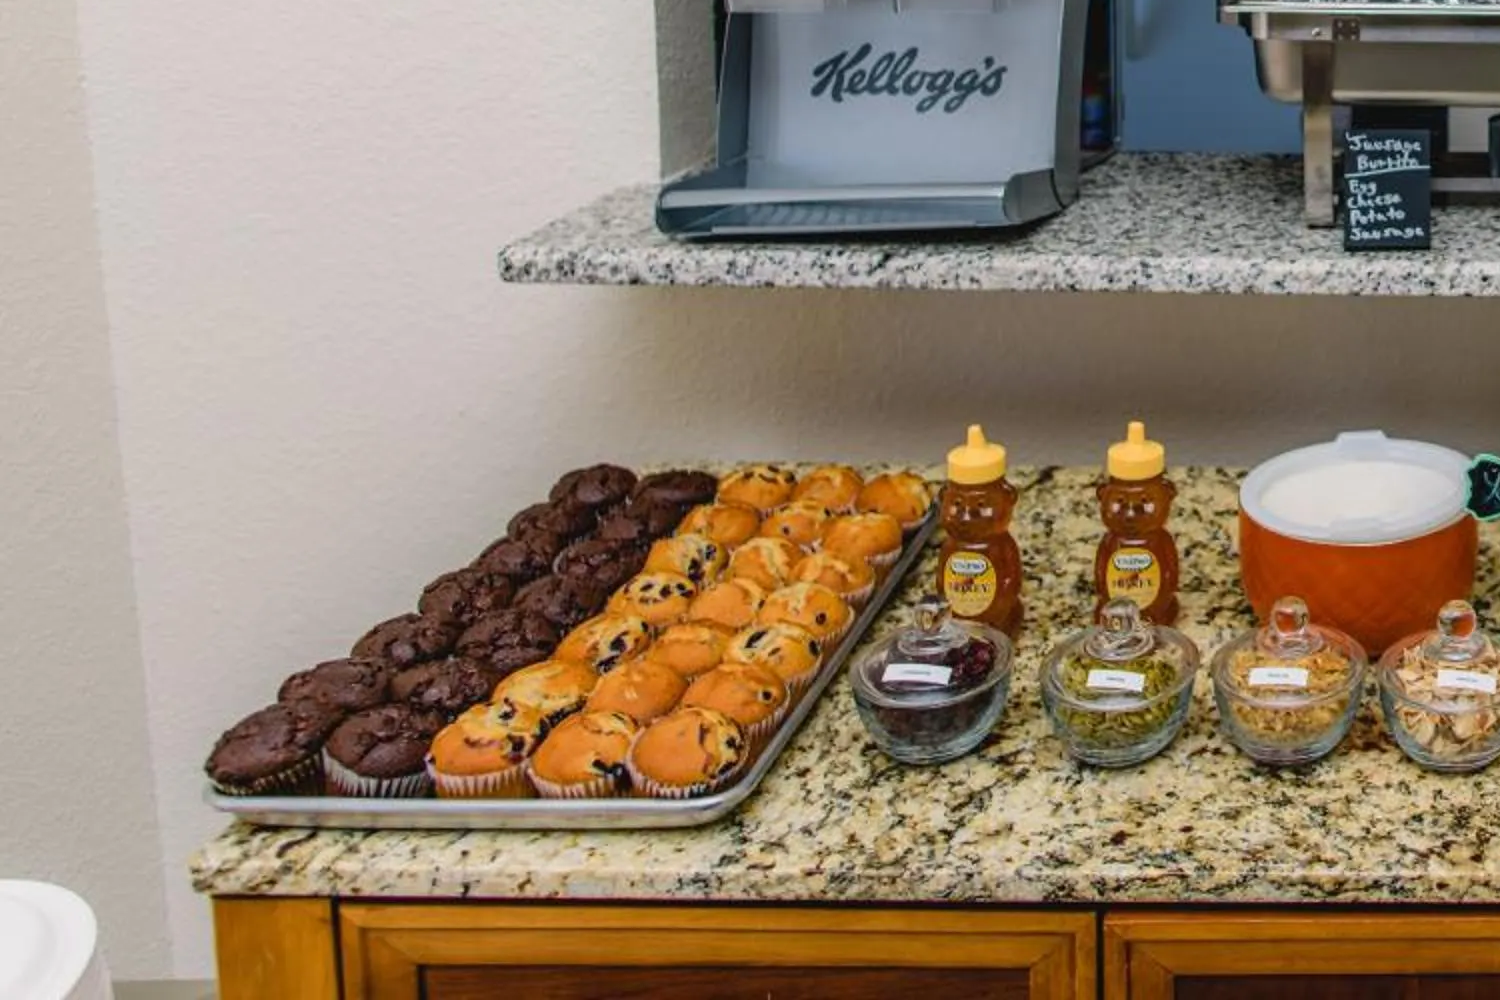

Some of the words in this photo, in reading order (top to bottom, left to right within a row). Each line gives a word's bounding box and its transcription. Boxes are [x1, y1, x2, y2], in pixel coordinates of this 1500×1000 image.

[811, 43, 1008, 113] Kellogg's
[1348, 179, 1378, 197] Egg
[1349, 207, 1406, 226] Potato
